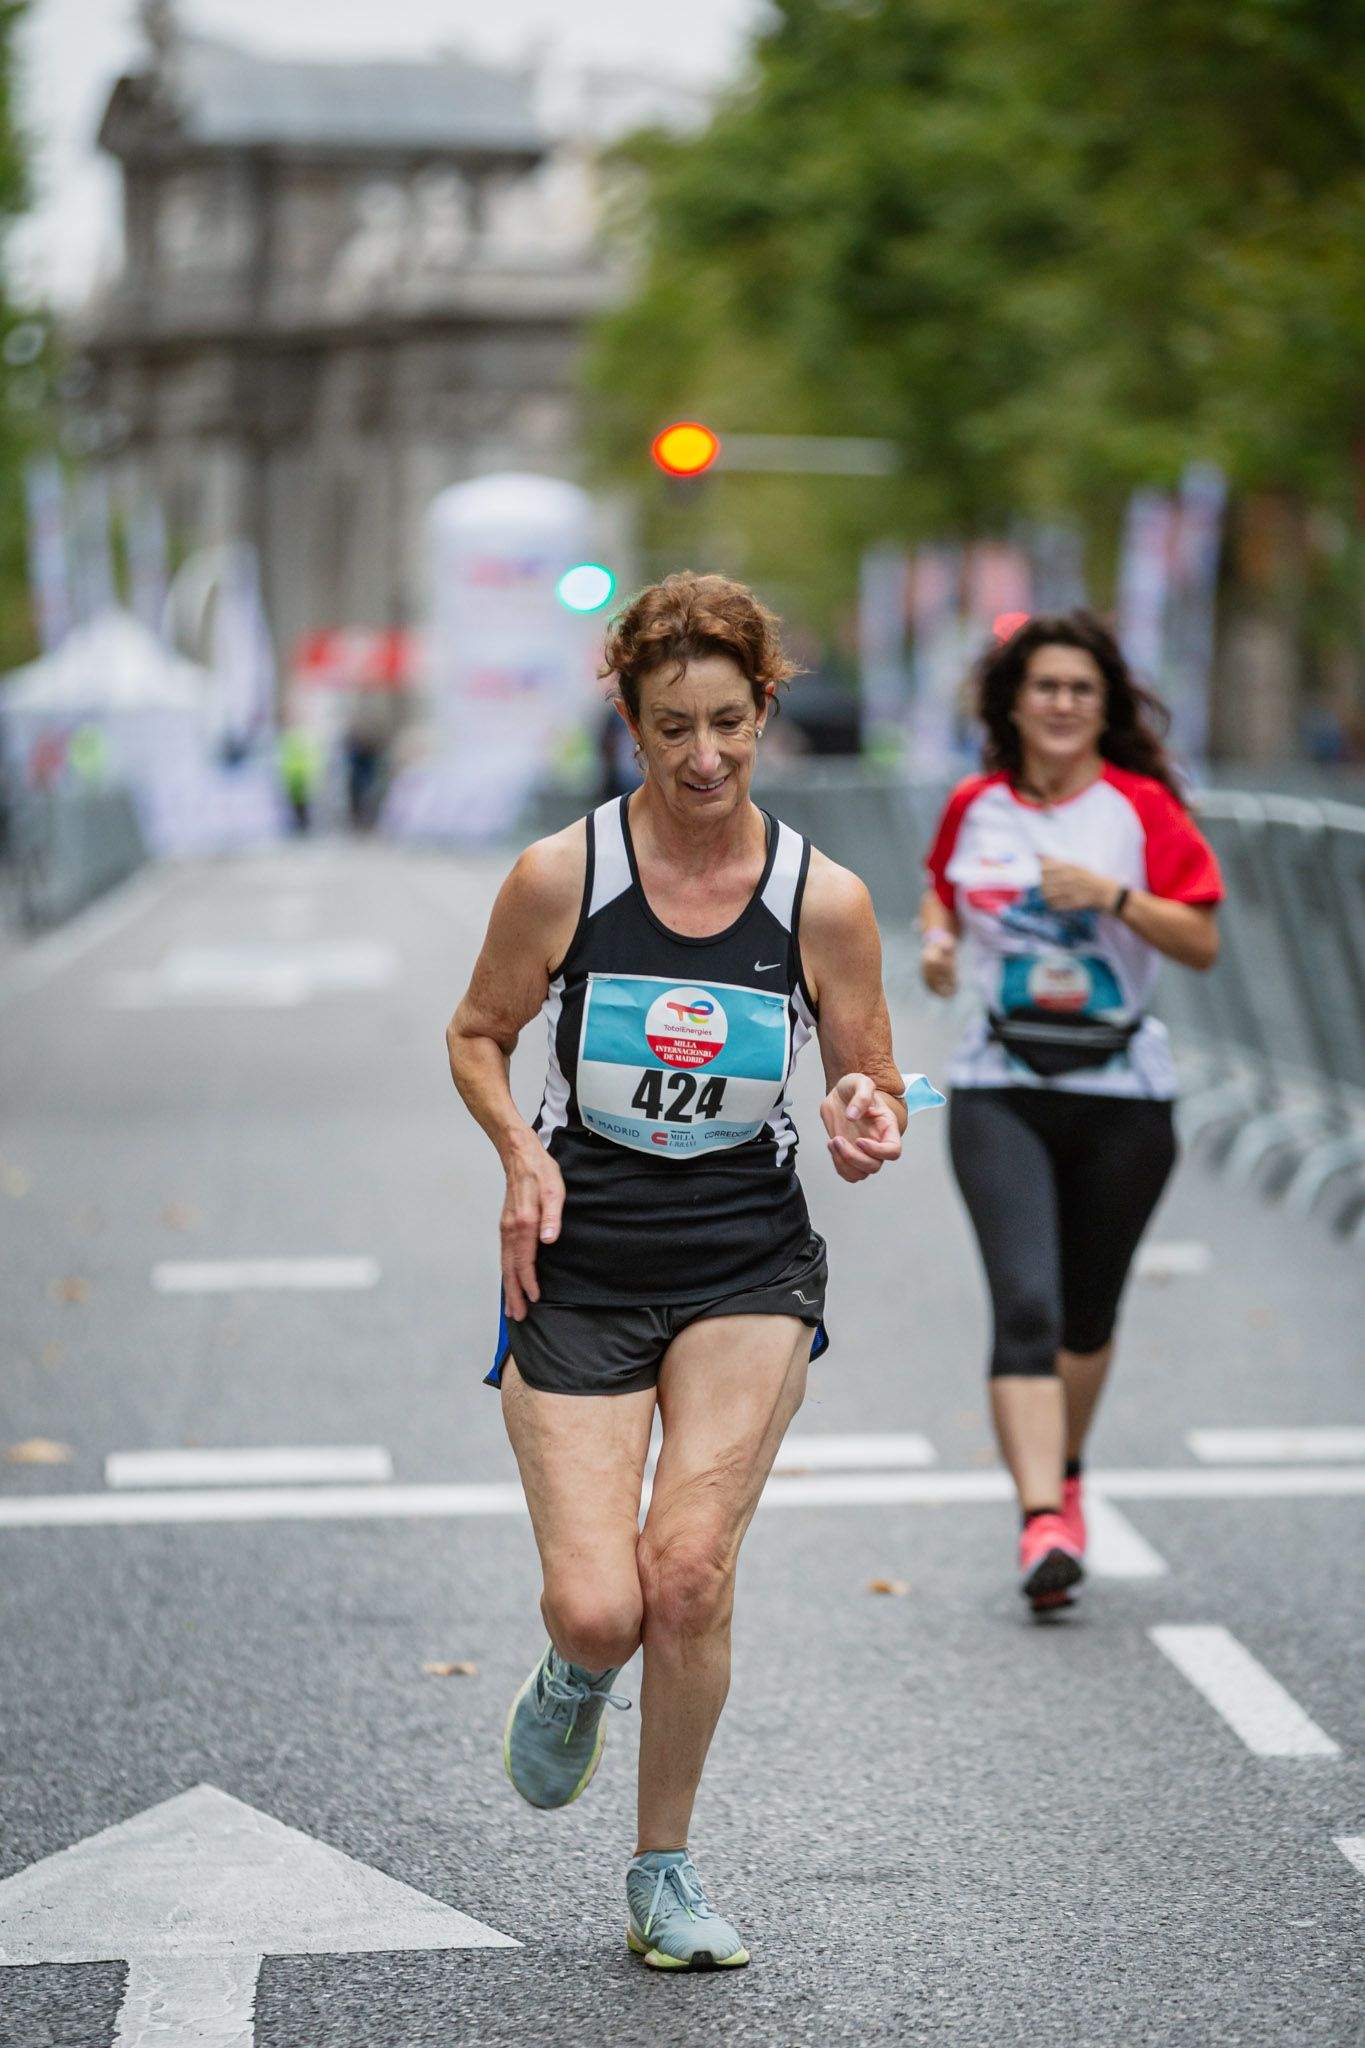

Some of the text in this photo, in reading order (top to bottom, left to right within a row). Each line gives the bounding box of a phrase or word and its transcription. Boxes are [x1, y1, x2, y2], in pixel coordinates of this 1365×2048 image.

[663, 1024, 713, 1036] TotalEnergies
[673, 1039, 697, 1049] MILLA
[655, 1045, 714, 1058] INTERNACIONAL
[663, 1053, 704, 1065] DE MADRID
[631, 1069, 728, 1123] 424
[598, 1120, 640, 1138] MADRID
